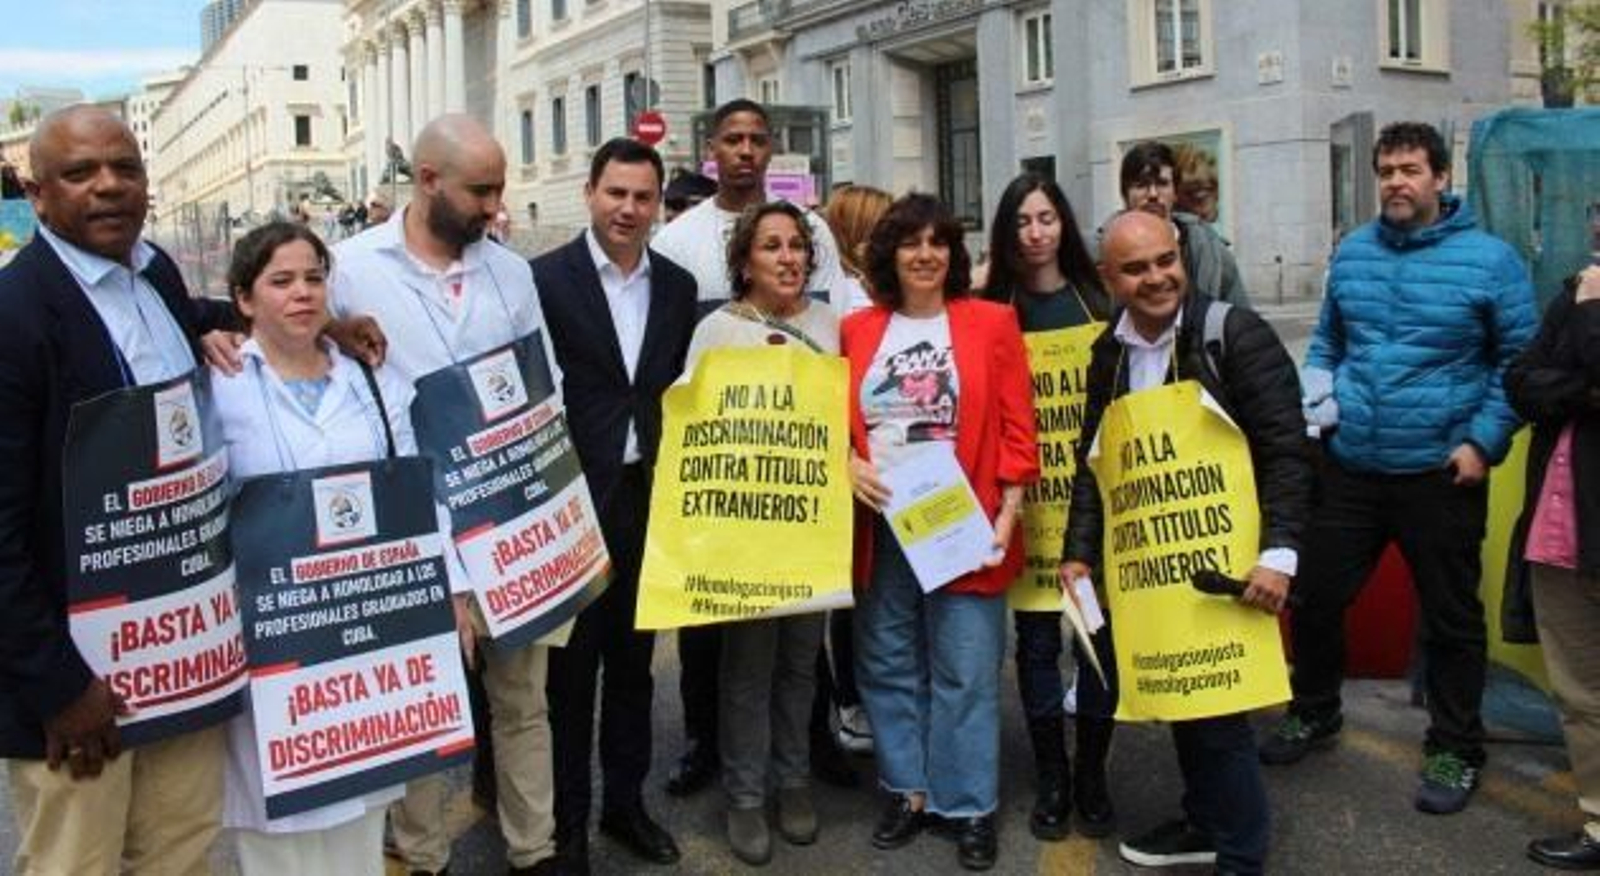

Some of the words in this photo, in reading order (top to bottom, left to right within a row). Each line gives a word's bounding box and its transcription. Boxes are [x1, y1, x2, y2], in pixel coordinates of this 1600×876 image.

[1060, 369, 1072, 396] A
[1075, 366, 1090, 394] L
[718, 386, 748, 416] ¡NO
[754, 385, 766, 411] A
[773, 385, 794, 412] LA
[682, 417, 828, 451] DISCRIMINACIÓN
[1135, 437, 1148, 467] A
[1150, 431, 1176, 463] LA
[445, 471, 462, 488] SE
[498, 452, 507, 467] A
[450, 446, 467, 462] EL
[680, 453, 748, 483] CONTRA
[754, 450, 828, 487] TÍTULOS
[104, 493, 122, 513] EL
[133, 476, 196, 508] GOBIERNO
[682, 489, 807, 523] EXTRANJEROS
[812, 498, 819, 524] !
[84, 524, 106, 544] SE
[110, 512, 155, 540] NIEGA
[158, 510, 170, 528] A
[491, 520, 556, 575] ¡BASTA
[553, 507, 571, 534] YA
[1150, 503, 1232, 545] TÍTULOS
[80, 529, 198, 574] PROFESIONALES
[270, 566, 287, 585] EL
[295, 554, 359, 580] GOBIERNO
[362, 550, 378, 569] DE
[379, 539, 421, 565] ESPAÑA
[1222, 545, 1232, 574] !
[256, 593, 275, 613] SE
[277, 588, 318, 609] NIEGA
[320, 587, 331, 603] A
[332, 566, 405, 598] HOMOLOGAR
[407, 566, 416, 581] A
[111, 603, 206, 662] ¡BASTA
[210, 590, 233, 627] YA
[254, 602, 360, 640] PROFESIONALES
[361, 587, 430, 618] GRADUADOS
[430, 584, 446, 602] EN
[288, 671, 370, 726] ¡BASTA
[372, 662, 402, 695] YA
[405, 654, 435, 687] DE
[268, 691, 462, 772] DISCRIMINACIÓN!
